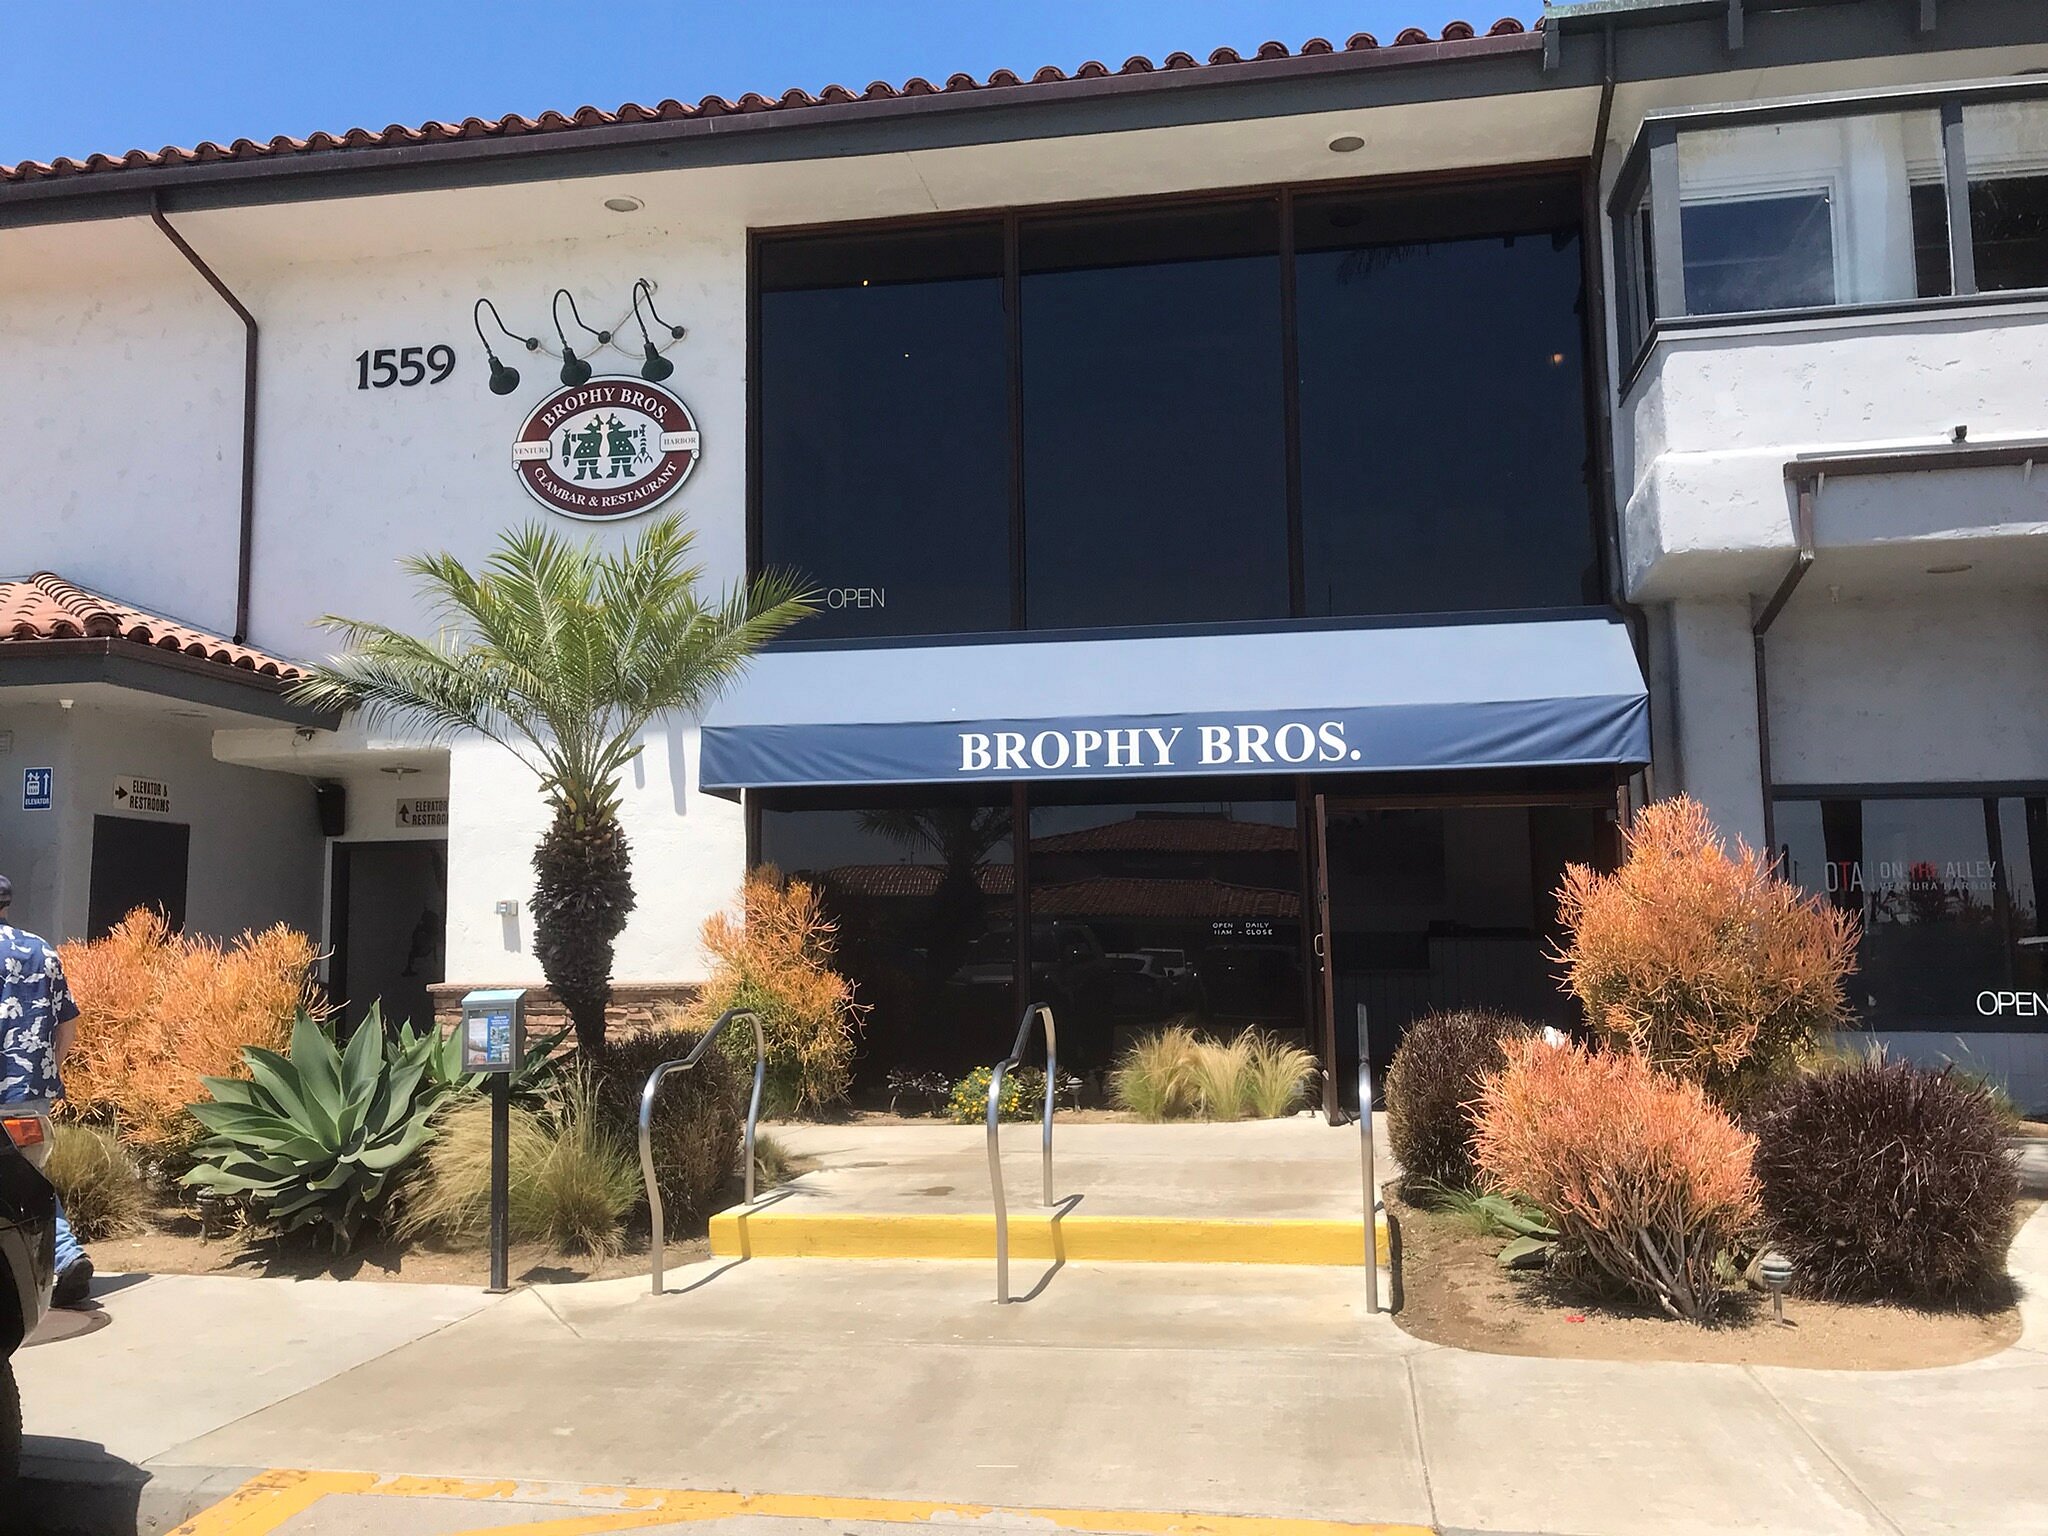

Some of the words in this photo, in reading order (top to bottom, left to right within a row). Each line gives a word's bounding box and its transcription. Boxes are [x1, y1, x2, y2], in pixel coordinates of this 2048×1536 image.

[356, 344, 456, 390] 1559
[541, 387, 615, 428] BROPHY
[620, 388, 668, 424] BROS.
[514, 446, 549, 455] VENTURA
[663, 436, 697, 446] HARBOR
[534, 467, 586, 506] CLAMBAR
[588, 495, 599, 507] &
[601, 461, 678, 507] RESTAURANT
[827, 587, 885, 609] OPEN
[957, 726, 1184, 771] BROPHY
[1197, 721, 1362, 765] BROS.
[132, 780, 162, 796] ELEVATOR
[25, 797, 50, 806] ELEVATOR
[129, 795, 170, 813] RESTROOMS
[412, 813, 449, 825] RESTROO
[1825, 861, 1864, 892] OTA
[1880, 862, 1903, 879] ON
[1946, 861, 1997, 879] ALLEY
[1976, 991, 2048, 1016] OPEN
